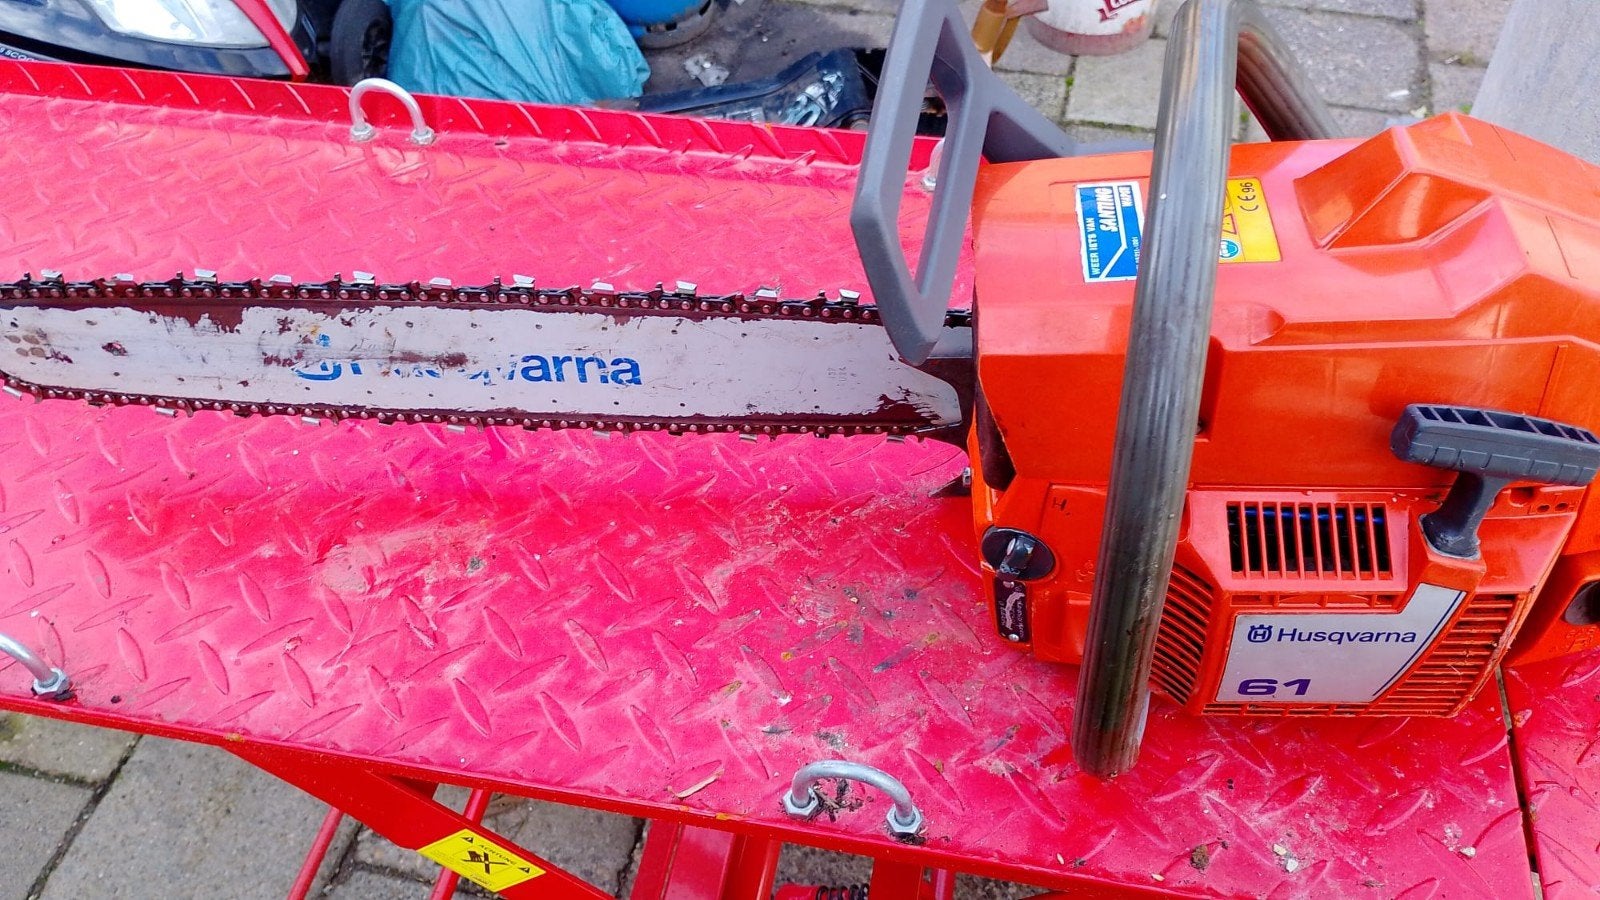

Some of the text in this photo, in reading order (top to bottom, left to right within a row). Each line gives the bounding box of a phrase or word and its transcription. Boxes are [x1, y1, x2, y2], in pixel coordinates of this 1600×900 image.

[1240, 182, 1255, 193] 96
[1095, 187, 1119, 232] SANTING
[1085, 217, 1101, 276] WEER IETS VAN
[1277, 628, 1417, 645] Husqvarna
[1237, 678, 1311, 696] 61
